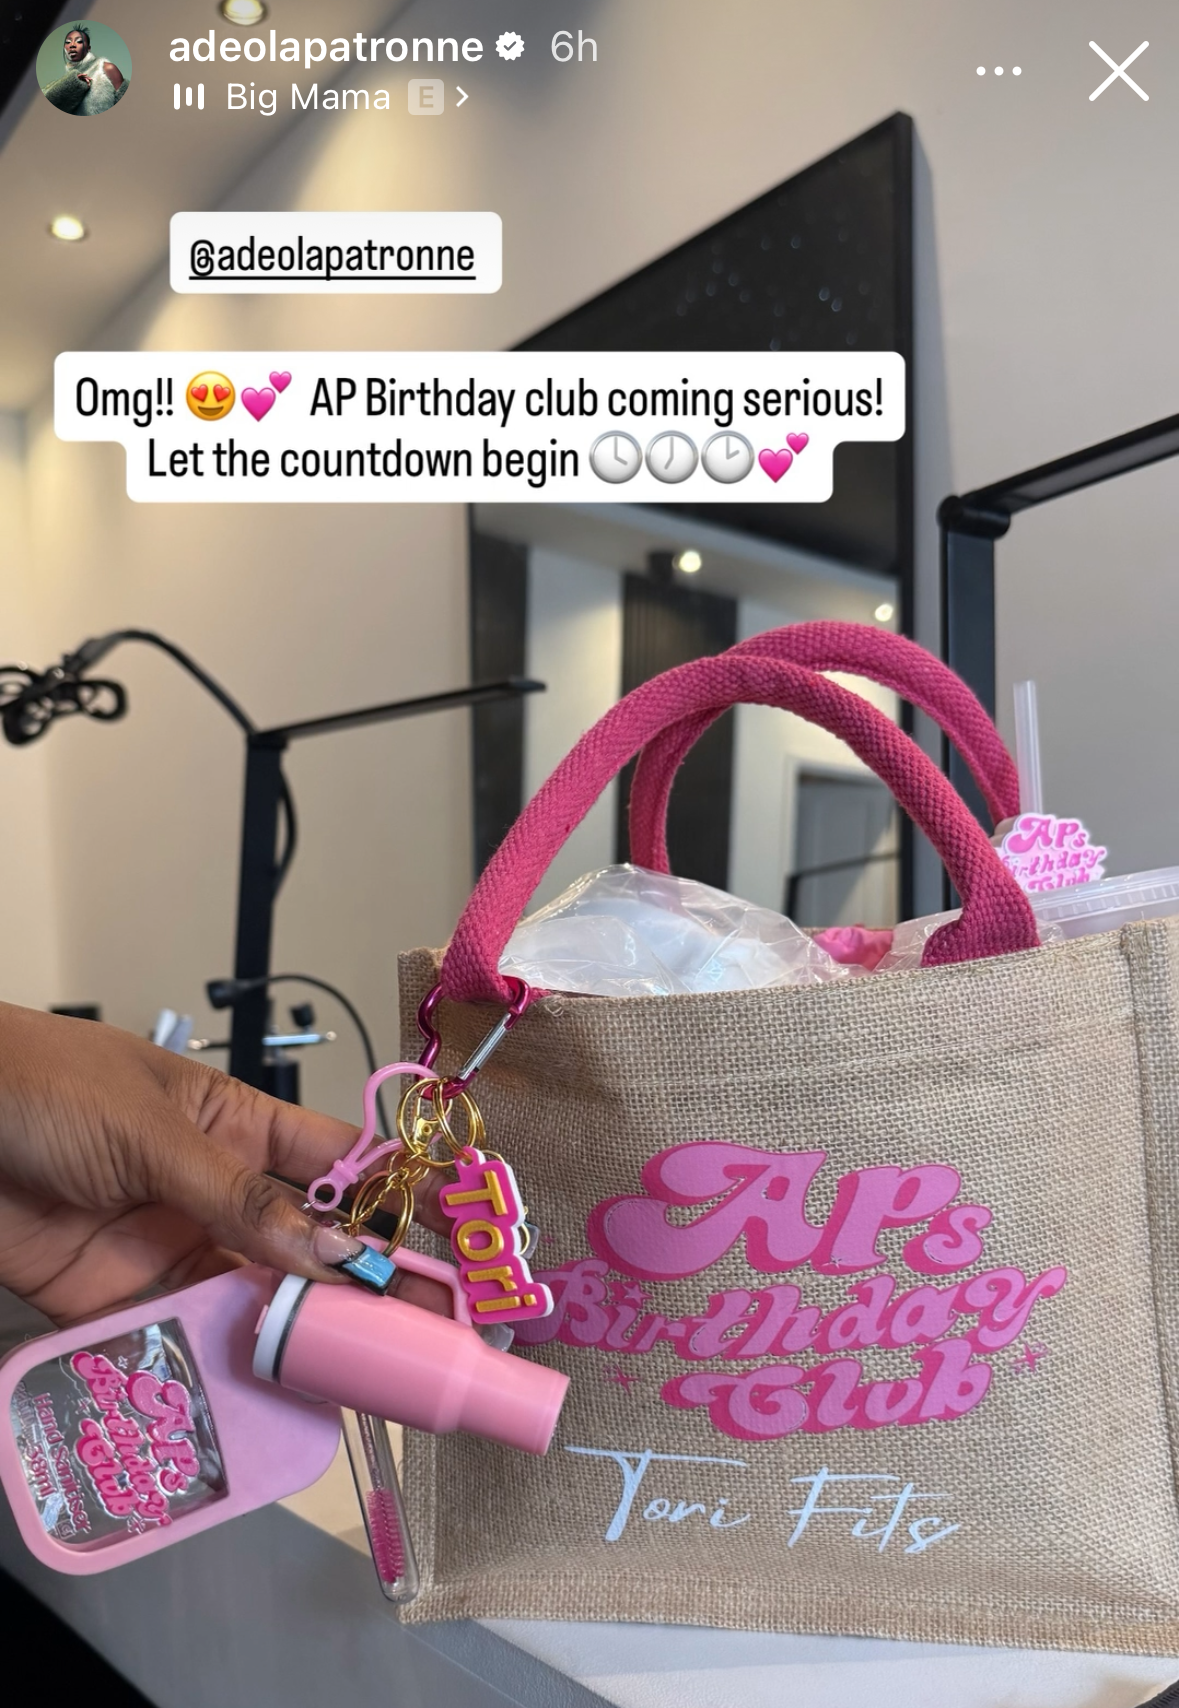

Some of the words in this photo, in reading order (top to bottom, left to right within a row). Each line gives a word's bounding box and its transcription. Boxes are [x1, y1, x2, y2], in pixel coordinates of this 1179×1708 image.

[445, 1169, 538, 1314] Tori
[587, 1140, 993, 1282] APs
[508, 1258, 1069, 1361] Birthday
[33, 1392, 65, 1445] Hand
[70, 1352, 173, 1526] Birthday
[661, 1337, 993, 1442] Club
[75, 1417, 139, 1519] Club
[564, 1446, 750, 1542] Tori
[787, 1466, 962, 1555] Fits
